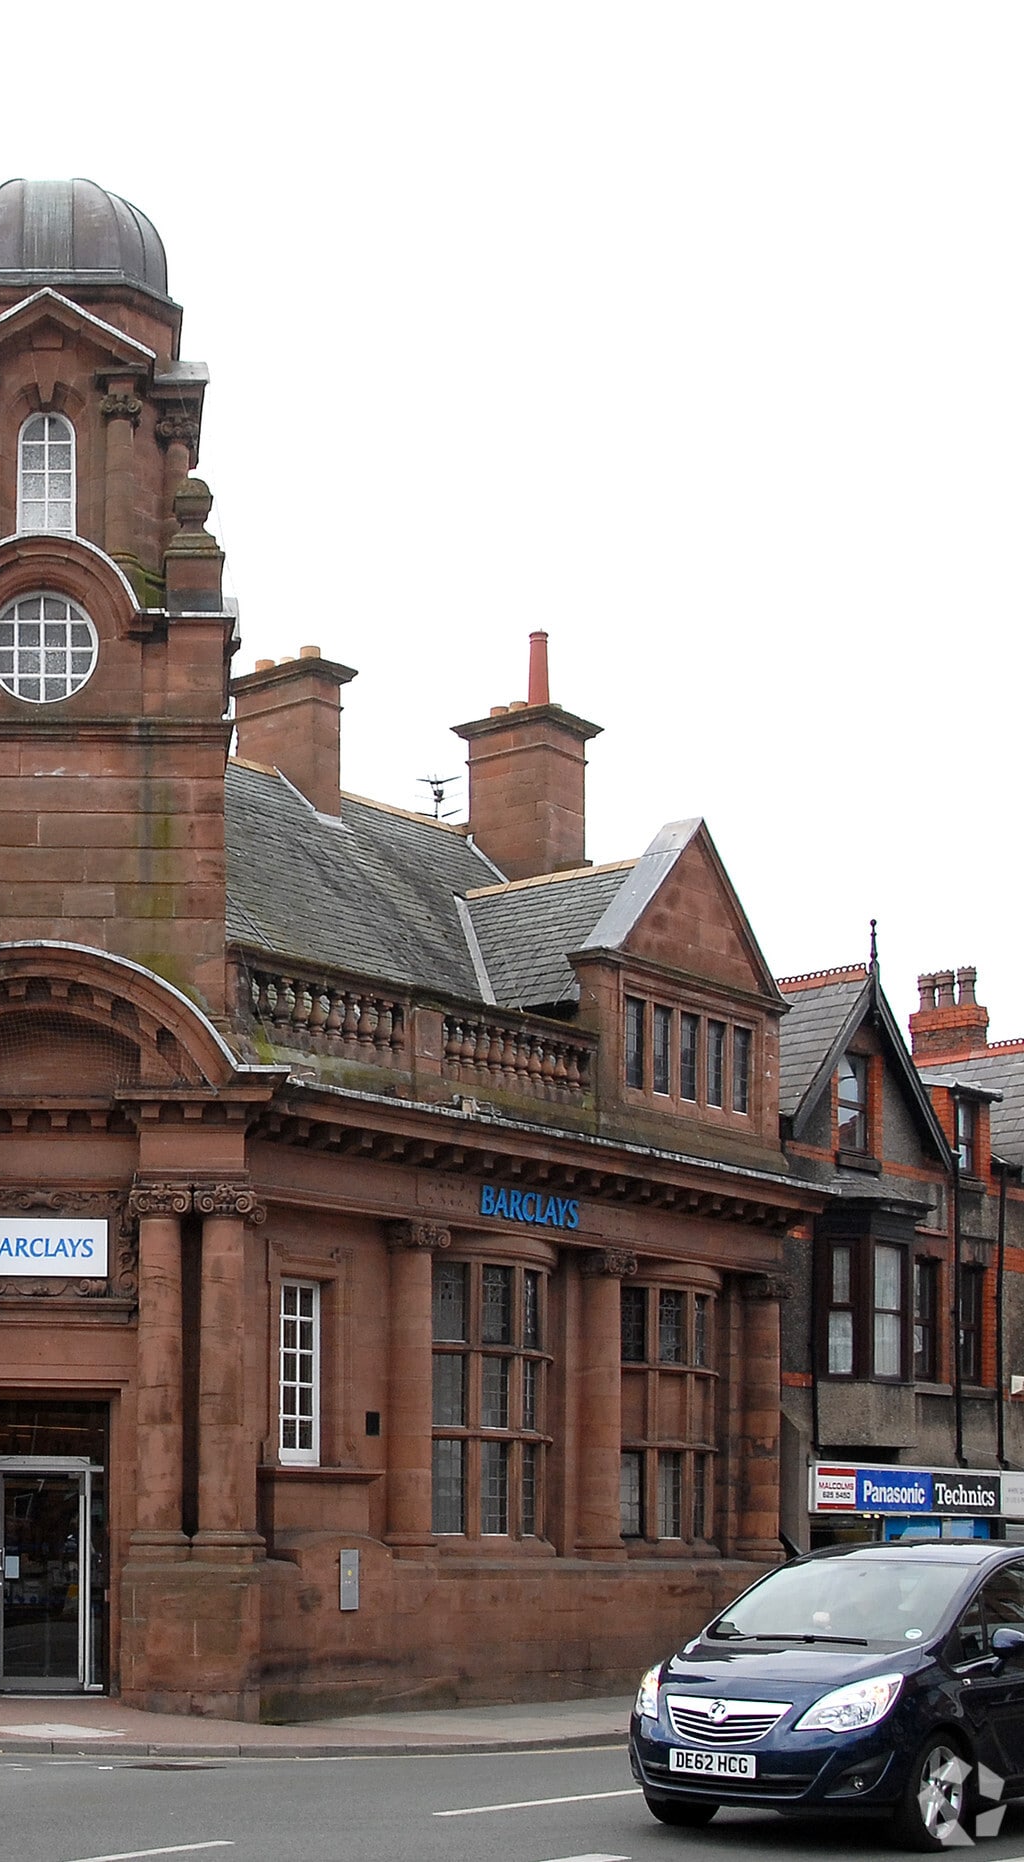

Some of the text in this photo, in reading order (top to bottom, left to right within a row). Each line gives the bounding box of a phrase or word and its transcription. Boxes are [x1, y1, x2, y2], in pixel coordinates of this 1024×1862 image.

[480, 1185, 580, 1229] BARCLAYS
[863, 1480, 925, 1505] Panasonic
[934, 1483, 995, 1506] Technics
[675, 1751, 748, 1774] DE62 HCG
